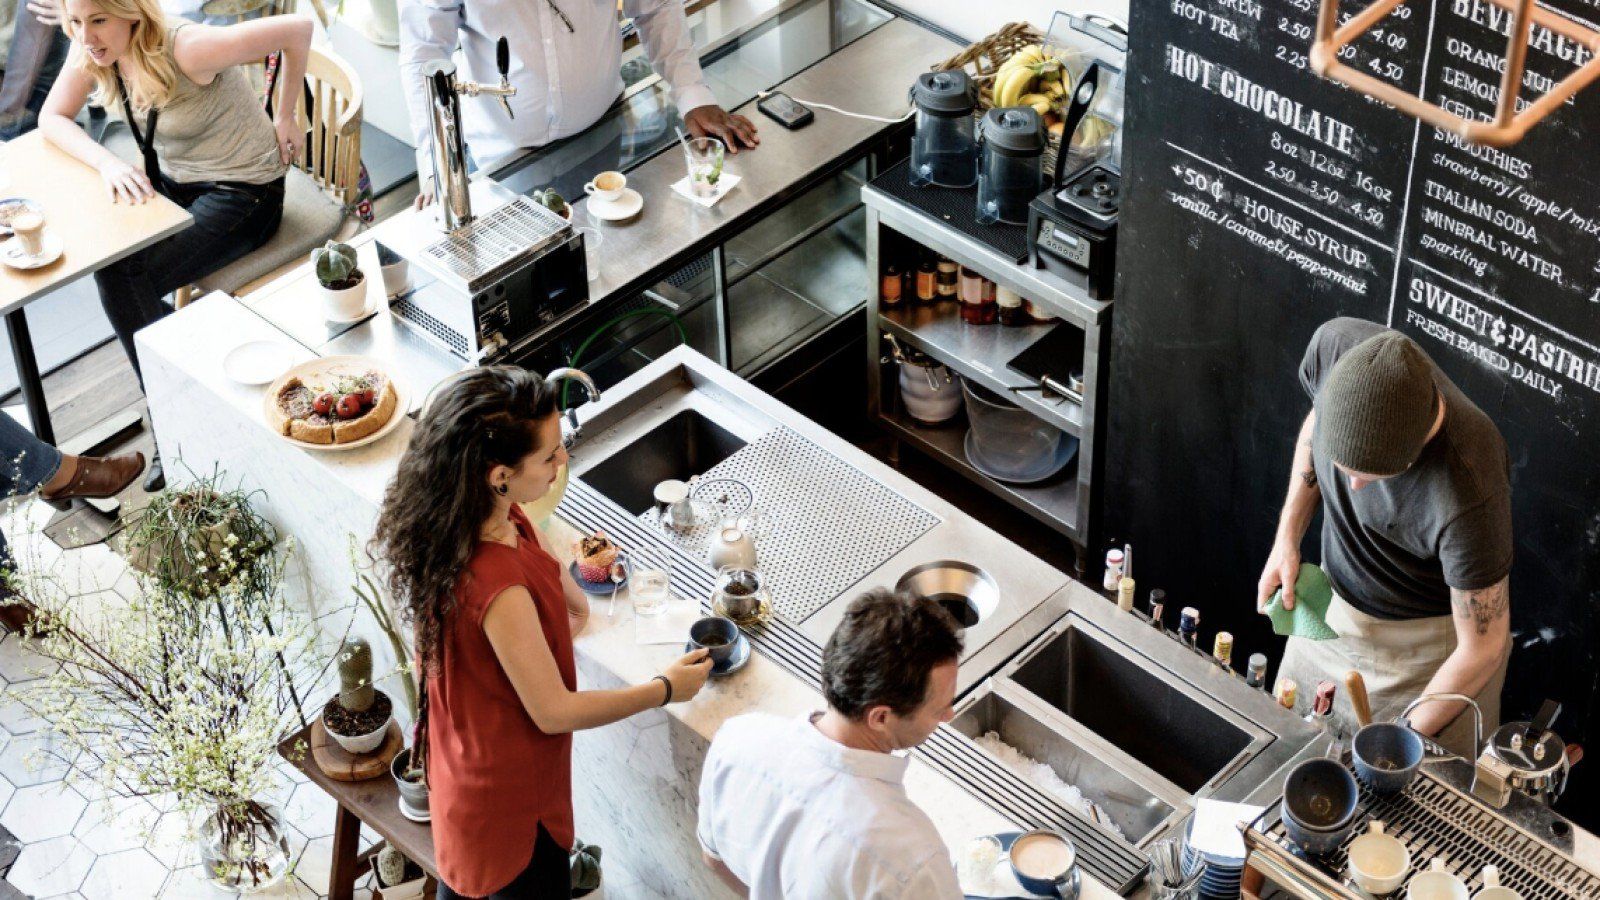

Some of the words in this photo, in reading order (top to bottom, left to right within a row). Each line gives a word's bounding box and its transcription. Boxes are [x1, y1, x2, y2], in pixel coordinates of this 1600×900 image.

[1173, 0, 1207, 25] HOT
[1209, 13, 1240, 41] TEA
[1278, 17, 1311, 39] 2.50
[1368, 57, 1404, 81] 4.50
[1372, 28, 1407, 50] 4.00
[1168, 44, 1214, 90] HOT
[1220, 70, 1355, 155] CHOCOLATE
[1439, 94, 1475, 122] ICED
[1243, 196, 1304, 241] HOUSE
[1304, 228, 1367, 269] SYRUP
[1309, 180, 1339, 204] 3.50
[1350, 202, 1384, 225] 4.50
[1425, 179, 1493, 221] ITALIAN
[1492, 210, 1539, 245] SODA
[1420, 234, 1488, 277] sparkling
[1422, 206, 1497, 252] MINERAL
[1500, 240, 1564, 285] WATER
[1406, 308, 1455, 346] FRESH
[1456, 334, 1510, 371] BAKED
[1511, 362, 1563, 397] DAILY
